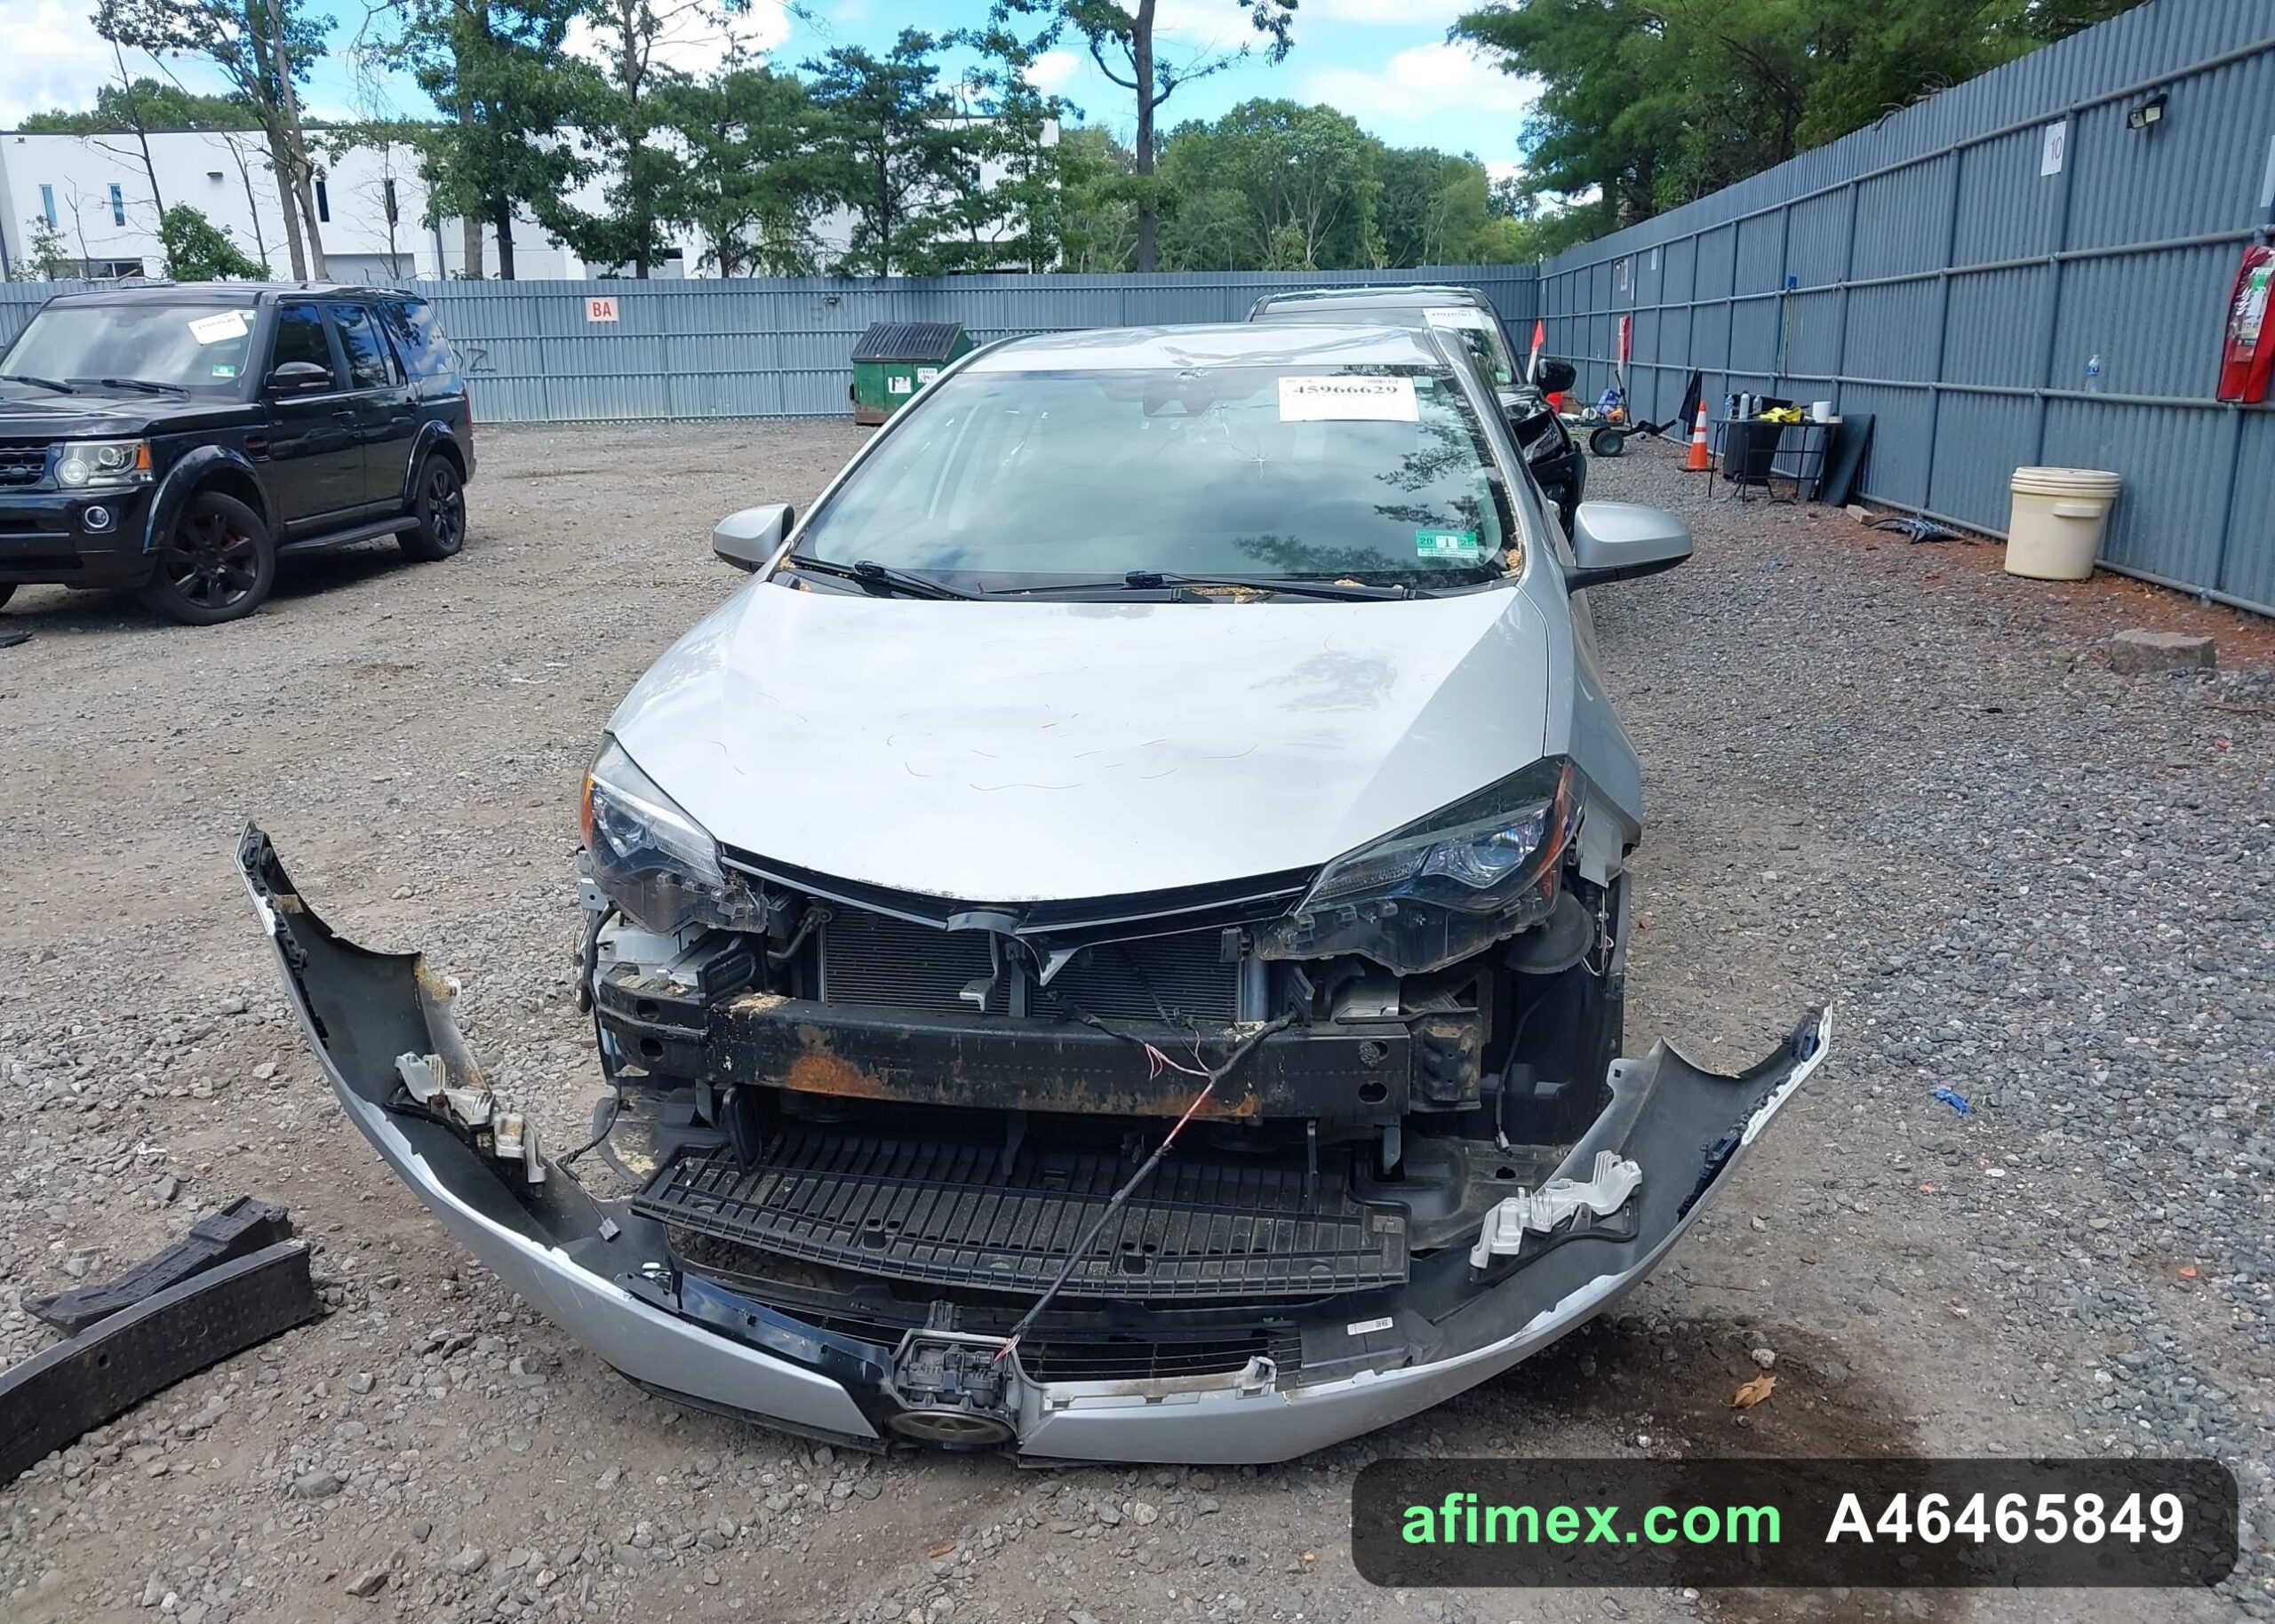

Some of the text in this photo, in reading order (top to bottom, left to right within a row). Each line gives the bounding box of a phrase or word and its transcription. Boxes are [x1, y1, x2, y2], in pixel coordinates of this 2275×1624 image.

[2051, 135, 2063, 161] 10
[592, 302, 612, 317] BA
[1293, 386, 1398, 394] 45966629
